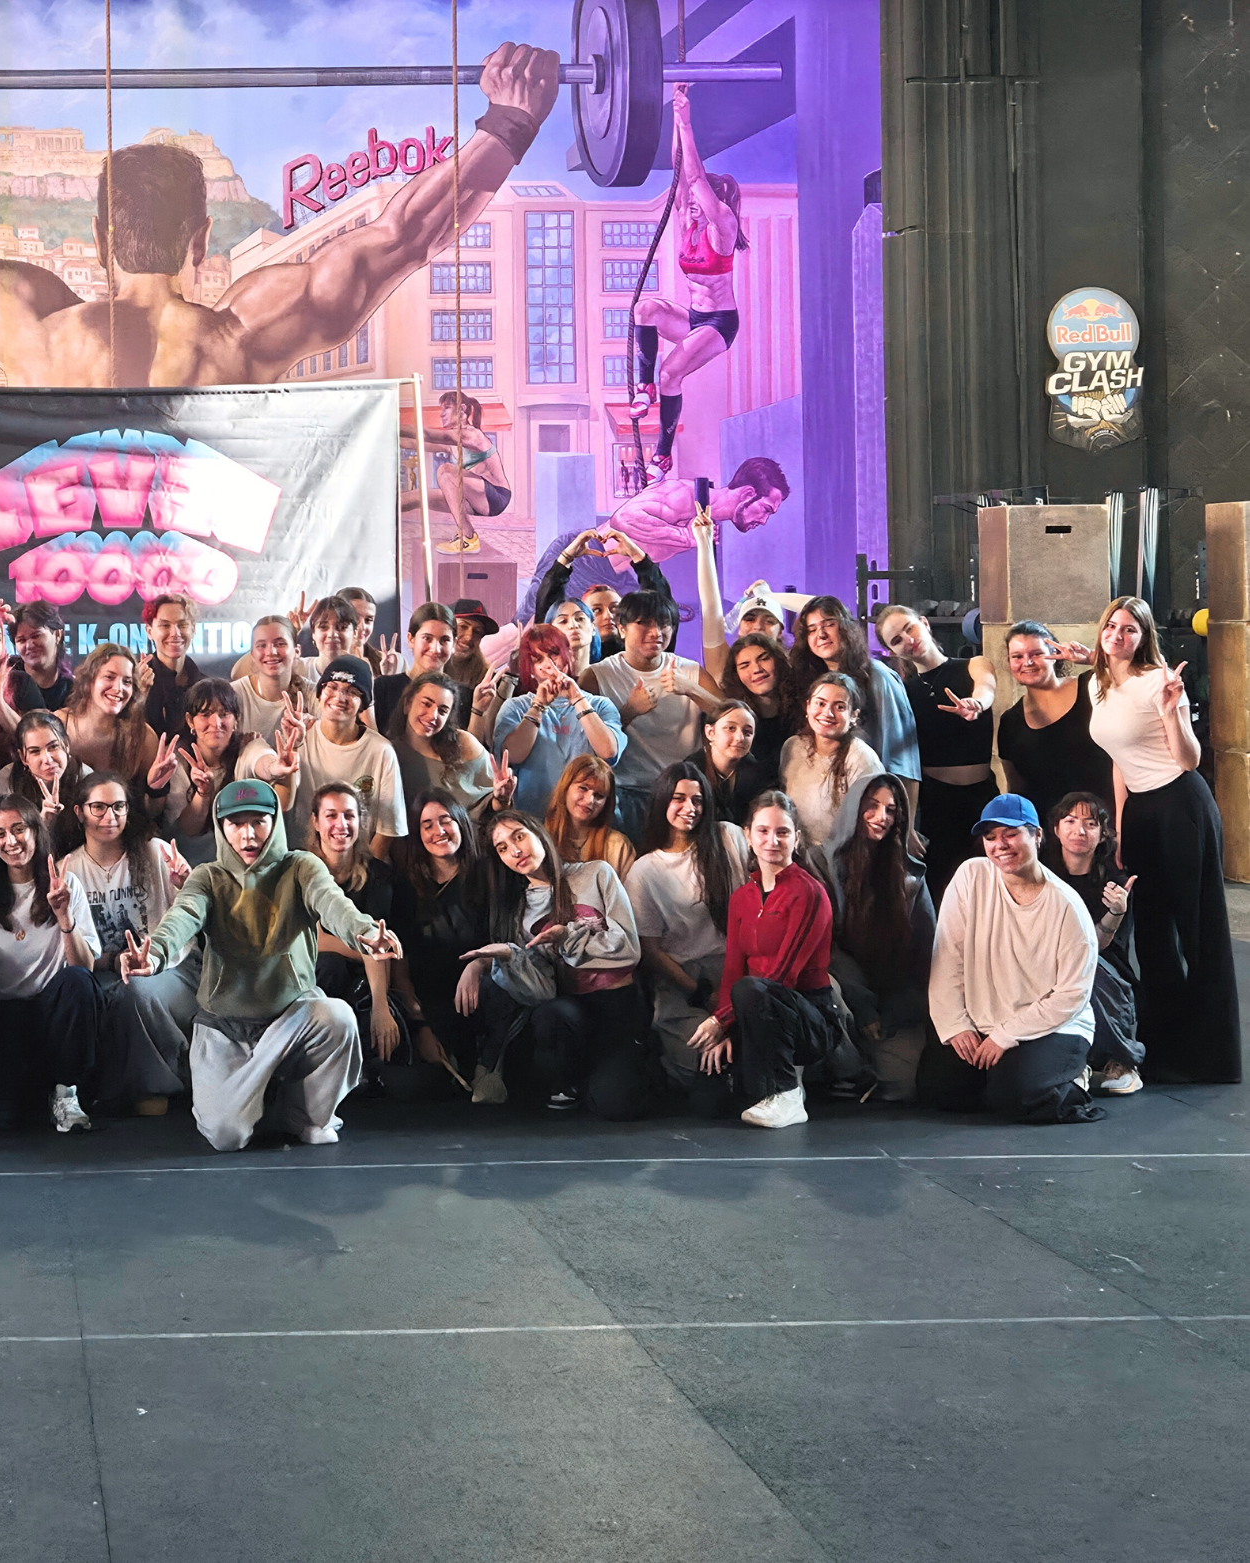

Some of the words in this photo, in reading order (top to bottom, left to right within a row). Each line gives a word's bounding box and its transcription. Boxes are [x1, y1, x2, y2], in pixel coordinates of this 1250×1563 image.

[282, 125, 454, 230] Reebok
[1055, 323, 1094, 345] Red
[1095, 321, 1132, 343] Bull
[1063, 350, 1132, 373] GYM
[1048, 366, 1144, 395] CLASH
